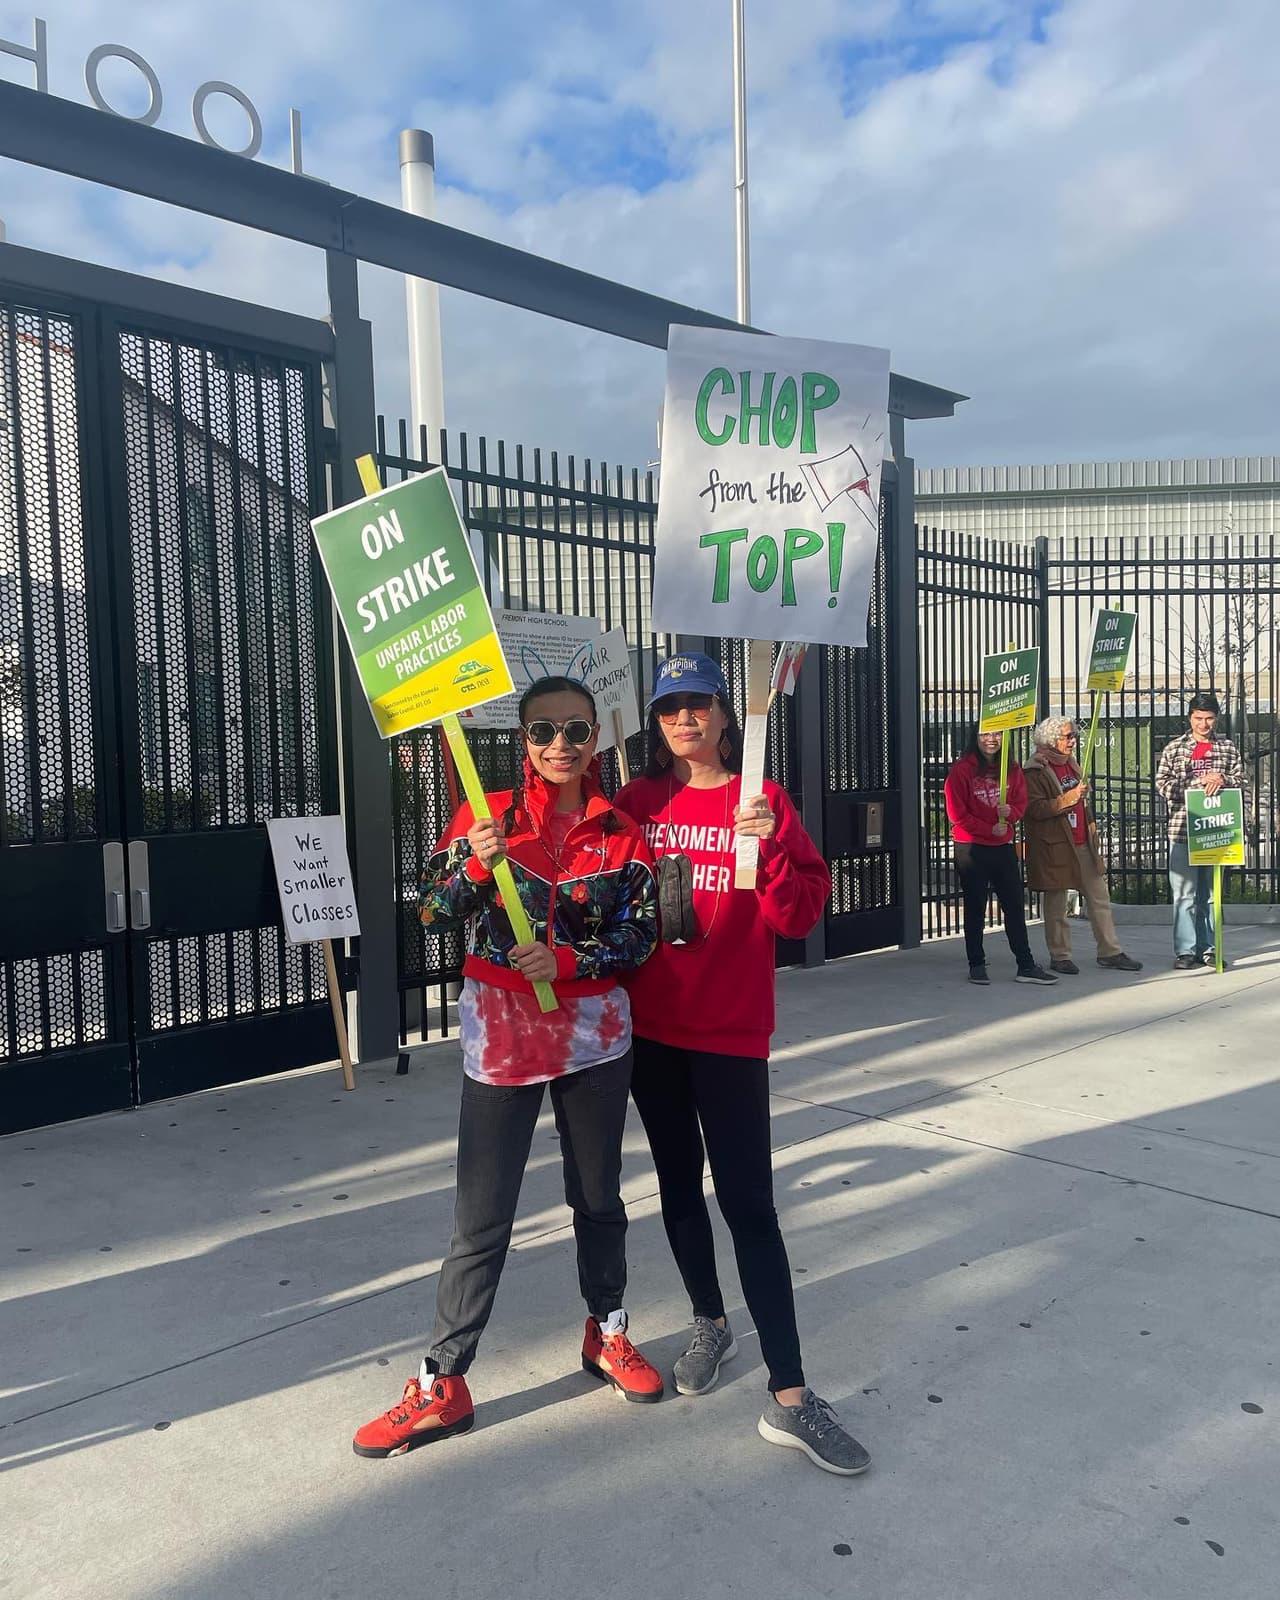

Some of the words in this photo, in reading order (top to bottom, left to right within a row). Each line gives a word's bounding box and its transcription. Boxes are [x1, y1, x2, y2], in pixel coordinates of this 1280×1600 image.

[695, 367, 840, 454] CHOP
[699, 468, 757, 512] from
[766, 472, 806, 504] the
[361, 508, 405, 560] ON
[700, 522, 846, 608] TOP!
[357, 547, 455, 633] STRIKE
[502, 614, 526, 623] FREMONT
[528, 617, 543, 625] HIGH
[544, 619, 569, 627] SCHOOL
[1105, 618, 1119, 631] ON
[376, 628, 423, 670] UNFAIR
[425, 603, 467, 641] LABOR
[1095, 637, 1126, 653] STRIKE
[395, 628, 462, 681] PRACTICES
[581, 647, 610, 675] FAIR
[1000, 657, 1018, 674] ON
[988, 673, 1030, 698] STRIKE
[1203, 795, 1221, 809] ON
[1194, 812, 1235, 831] STRIKE
[295, 833, 322, 852] WE
[640, 823, 737, 853] HENOMEN
[293, 856, 329, 871] Want
[283, 872, 346, 894] Smaller
[292, 902, 353, 924] Classes
